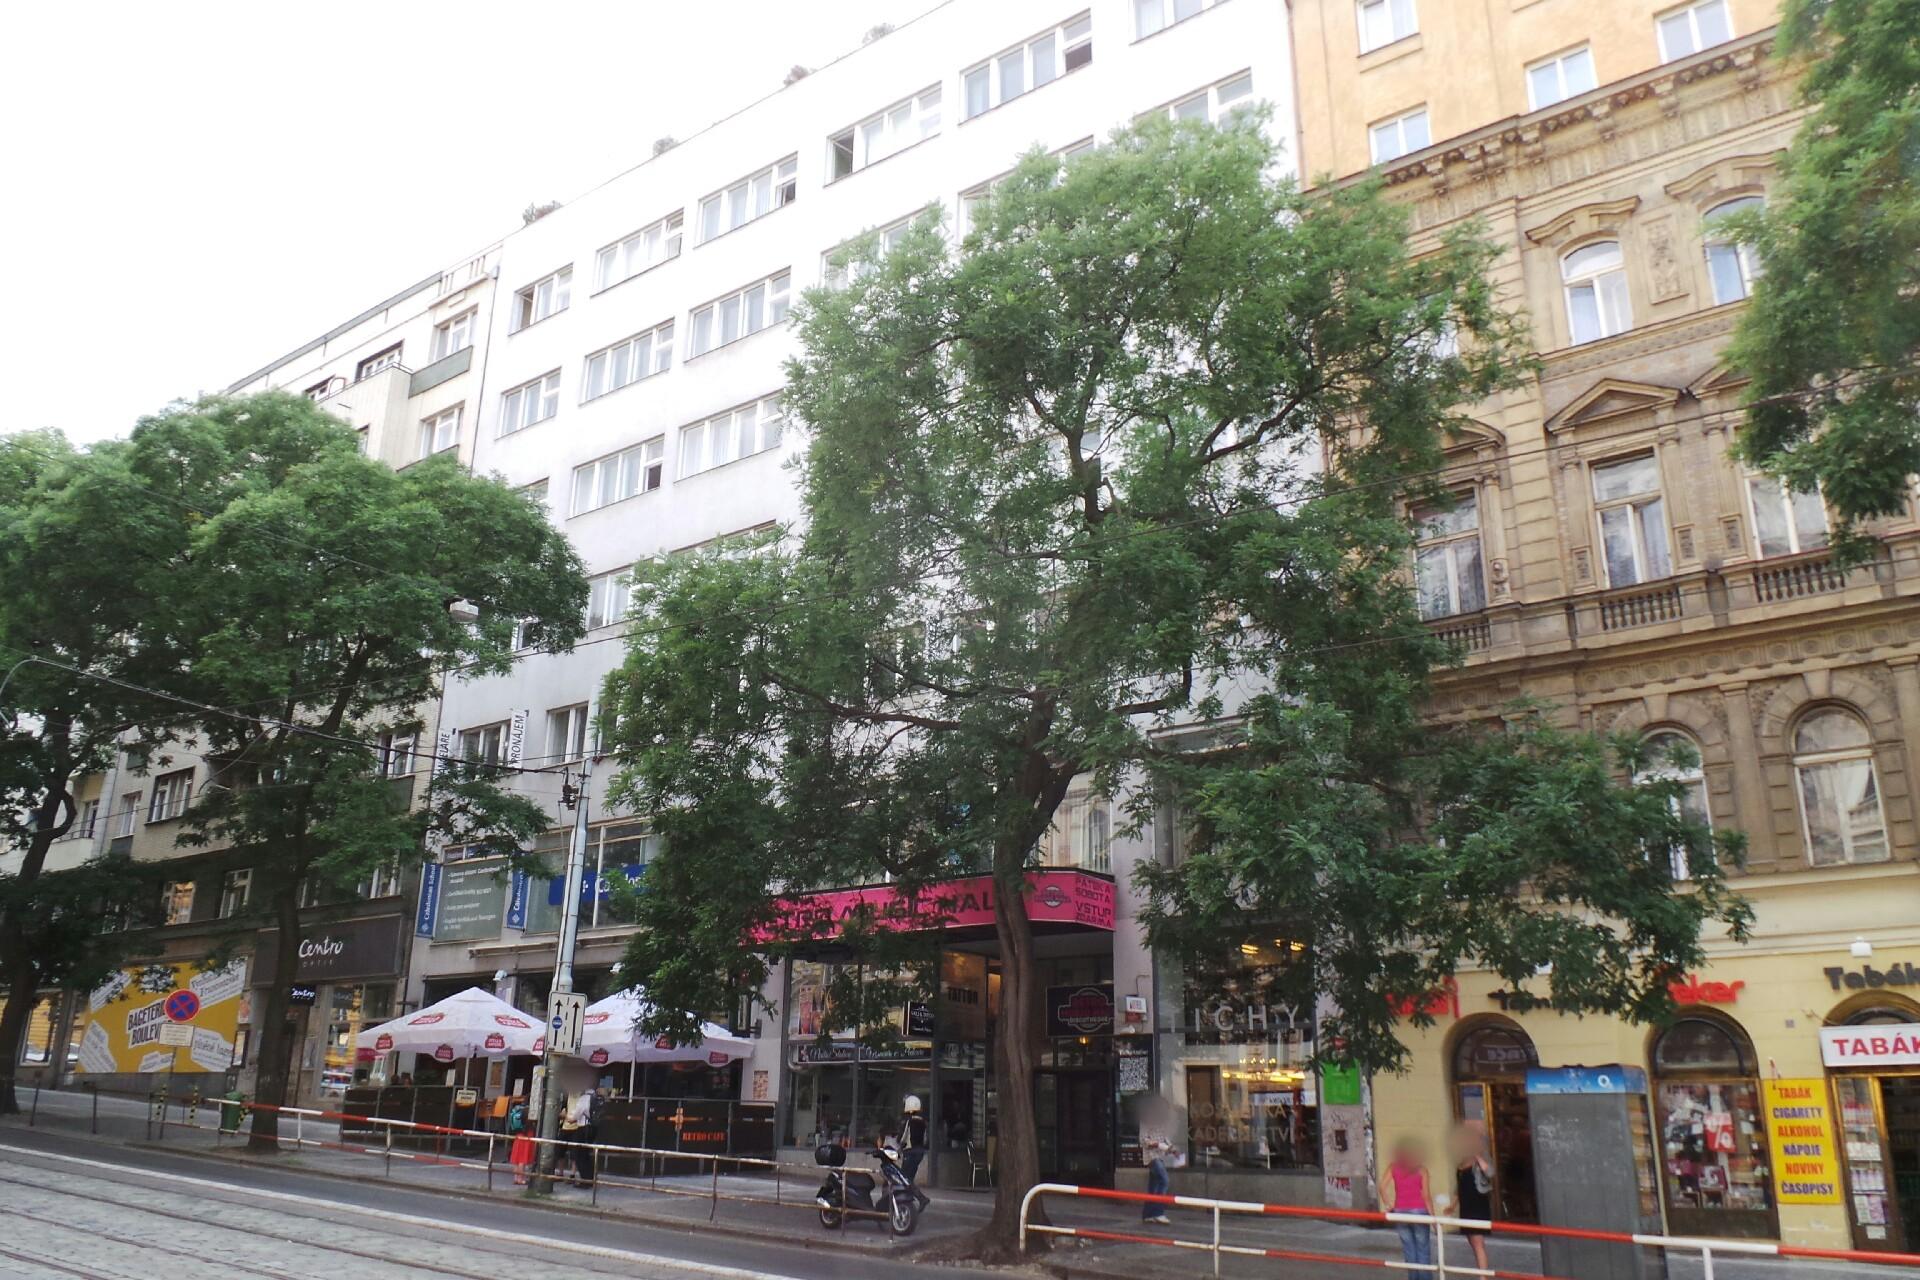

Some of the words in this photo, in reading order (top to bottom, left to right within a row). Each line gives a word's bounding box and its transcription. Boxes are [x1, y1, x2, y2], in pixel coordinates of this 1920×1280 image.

[436, 732, 450, 778] ANCELARE
[1075, 900, 1112, 918] VSTUP
[298, 936, 343, 958] Centro
[291, 988, 316, 998] entro
[128, 1000, 166, 1030] BAGETERI
[131, 1022, 162, 1046] BOULEV
[1773, 1107, 1823, 1118] CIGARETY
[1778, 1126, 1824, 1138] ALKOHOL
[1785, 1162, 1824, 1175] NOVINY
[1781, 1180, 1834, 1195] ČASOPISY
